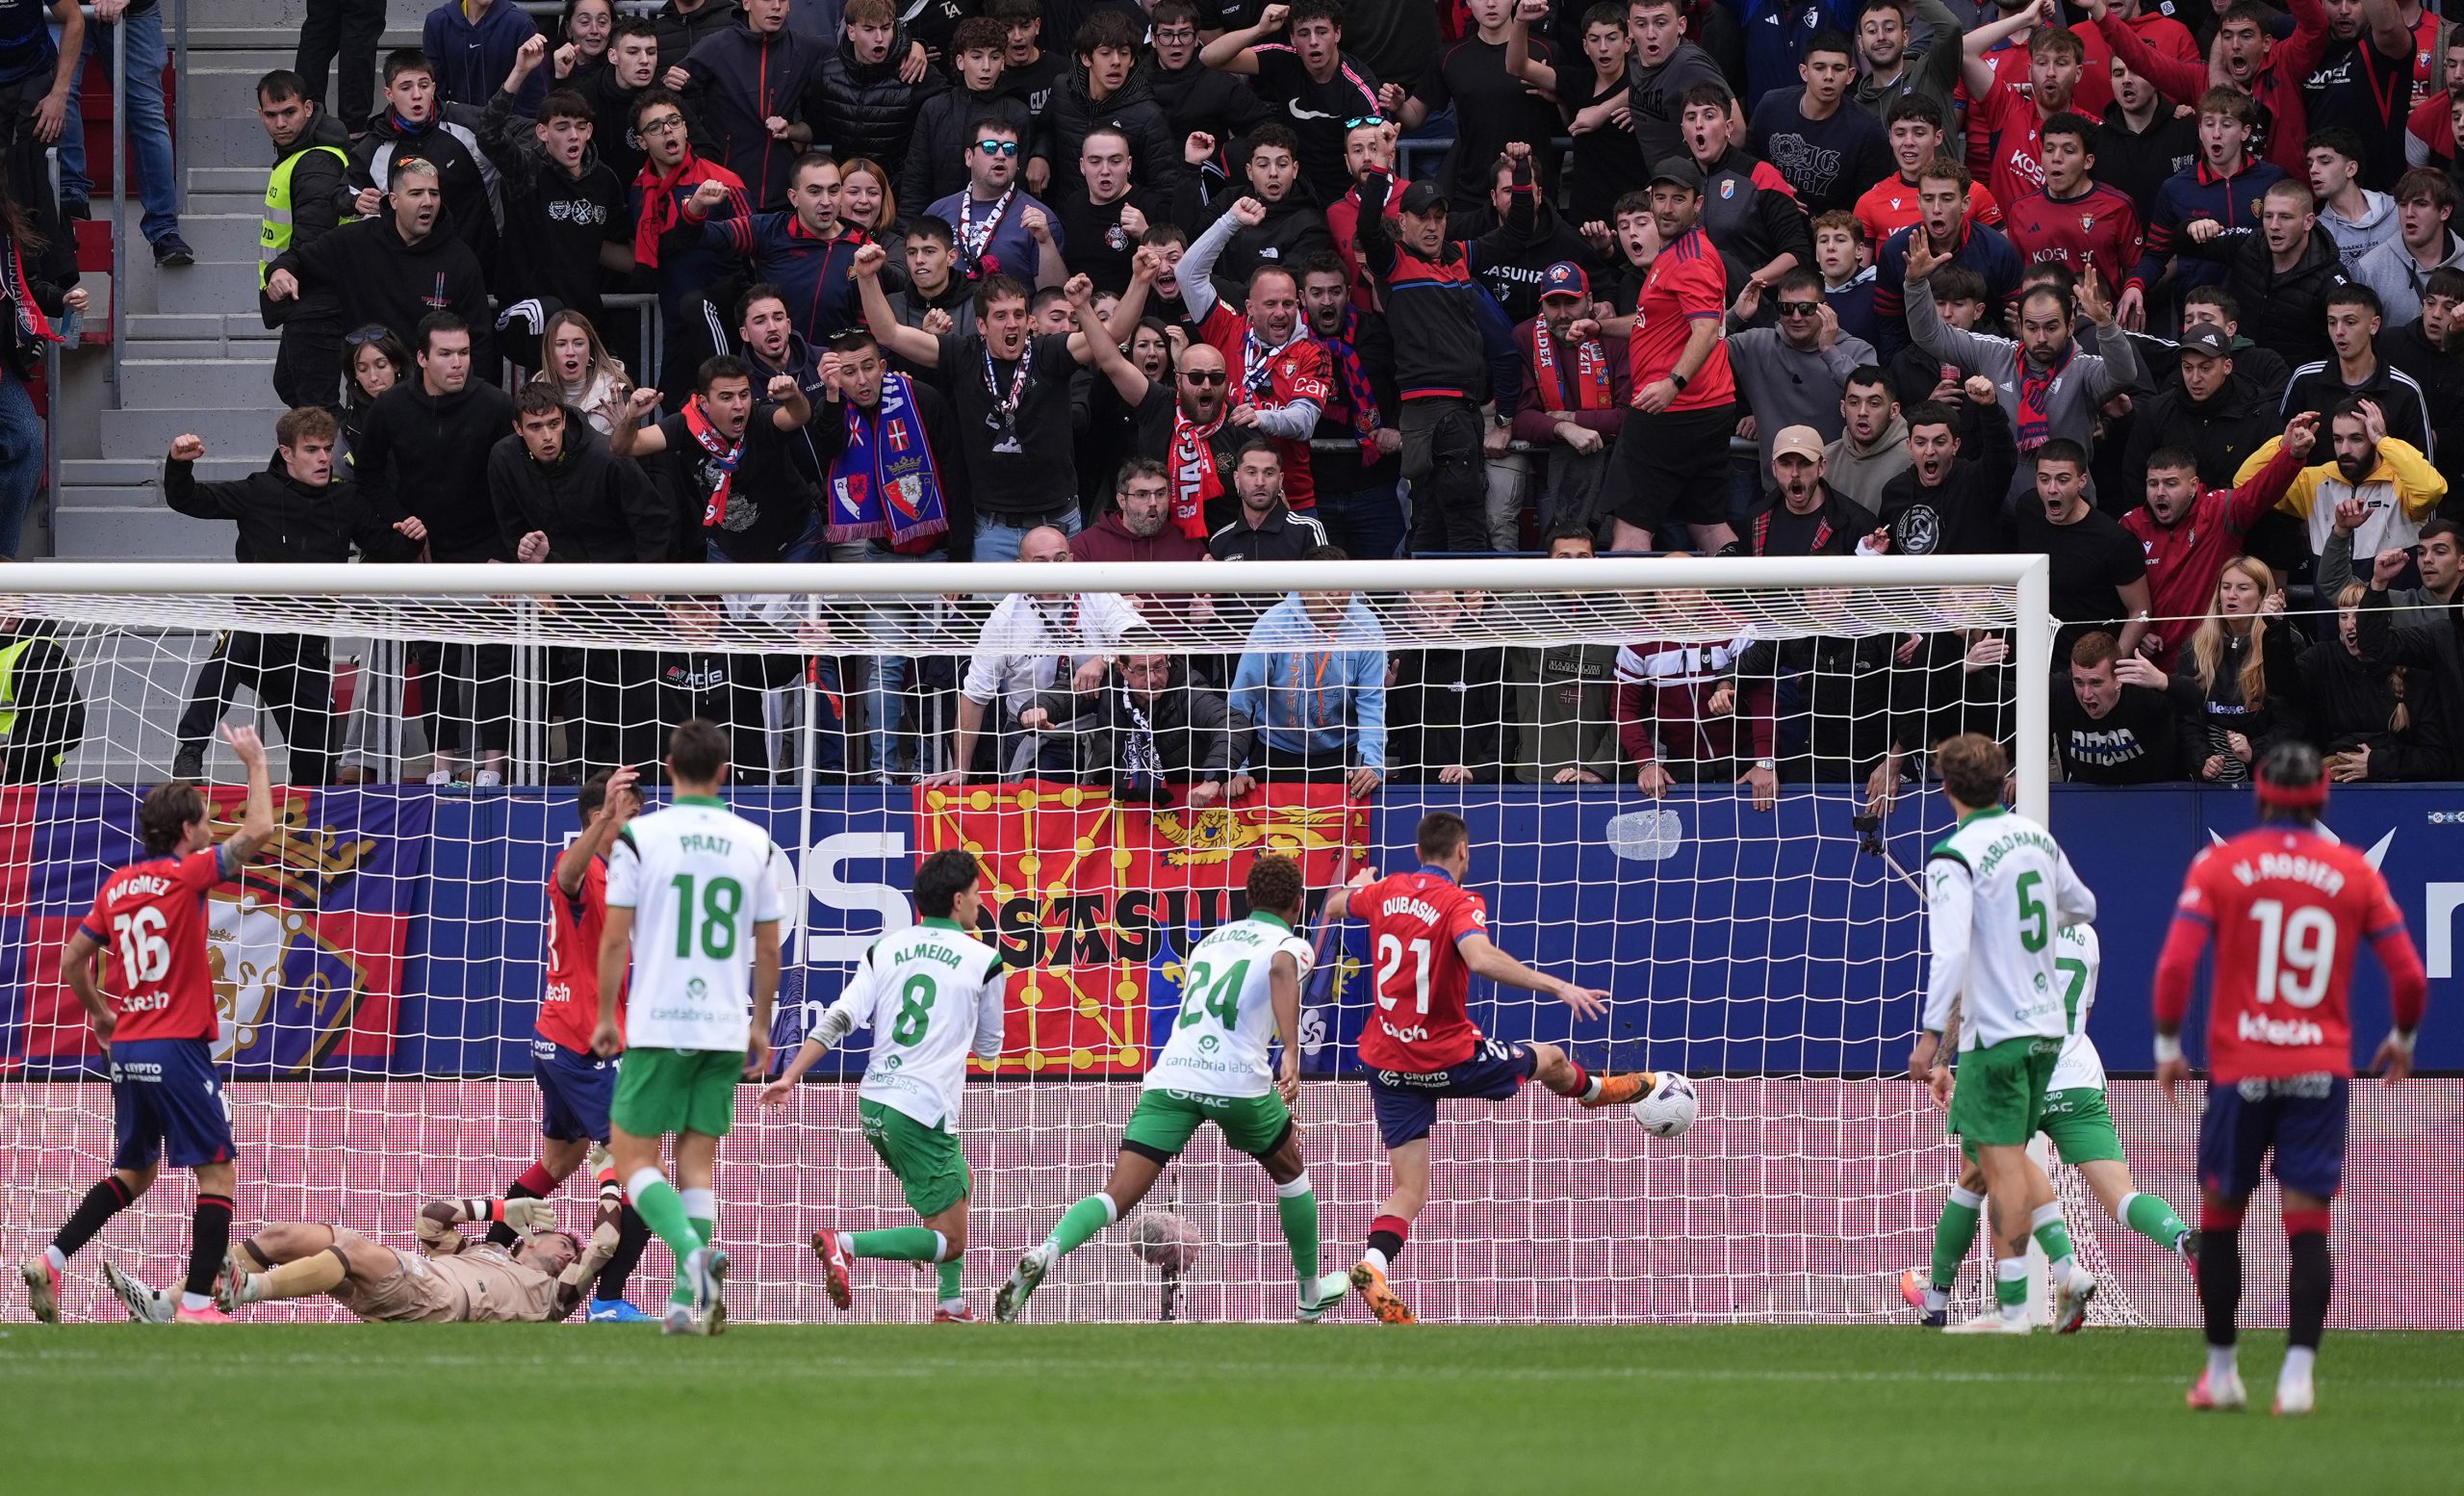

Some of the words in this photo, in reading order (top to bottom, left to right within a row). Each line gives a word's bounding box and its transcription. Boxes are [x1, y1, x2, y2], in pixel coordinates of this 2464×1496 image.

[680, 835, 732, 856] PRATI
[114, 906, 170, 990] 16
[672, 874, 742, 960] 18
[1382, 896, 1442, 927] DUBASIN
[2016, 869, 2047, 953] 5
[894, 943, 963, 969] ALMEIDA
[1376, 933, 1431, 1014] 21
[2249, 899, 2336, 1008] 19
[892, 973, 937, 1047] 8
[1179, 960, 1250, 1031] 24
[1166, 1057, 1225, 1071] cantabria
[1228, 1061, 1254, 1073] labs
